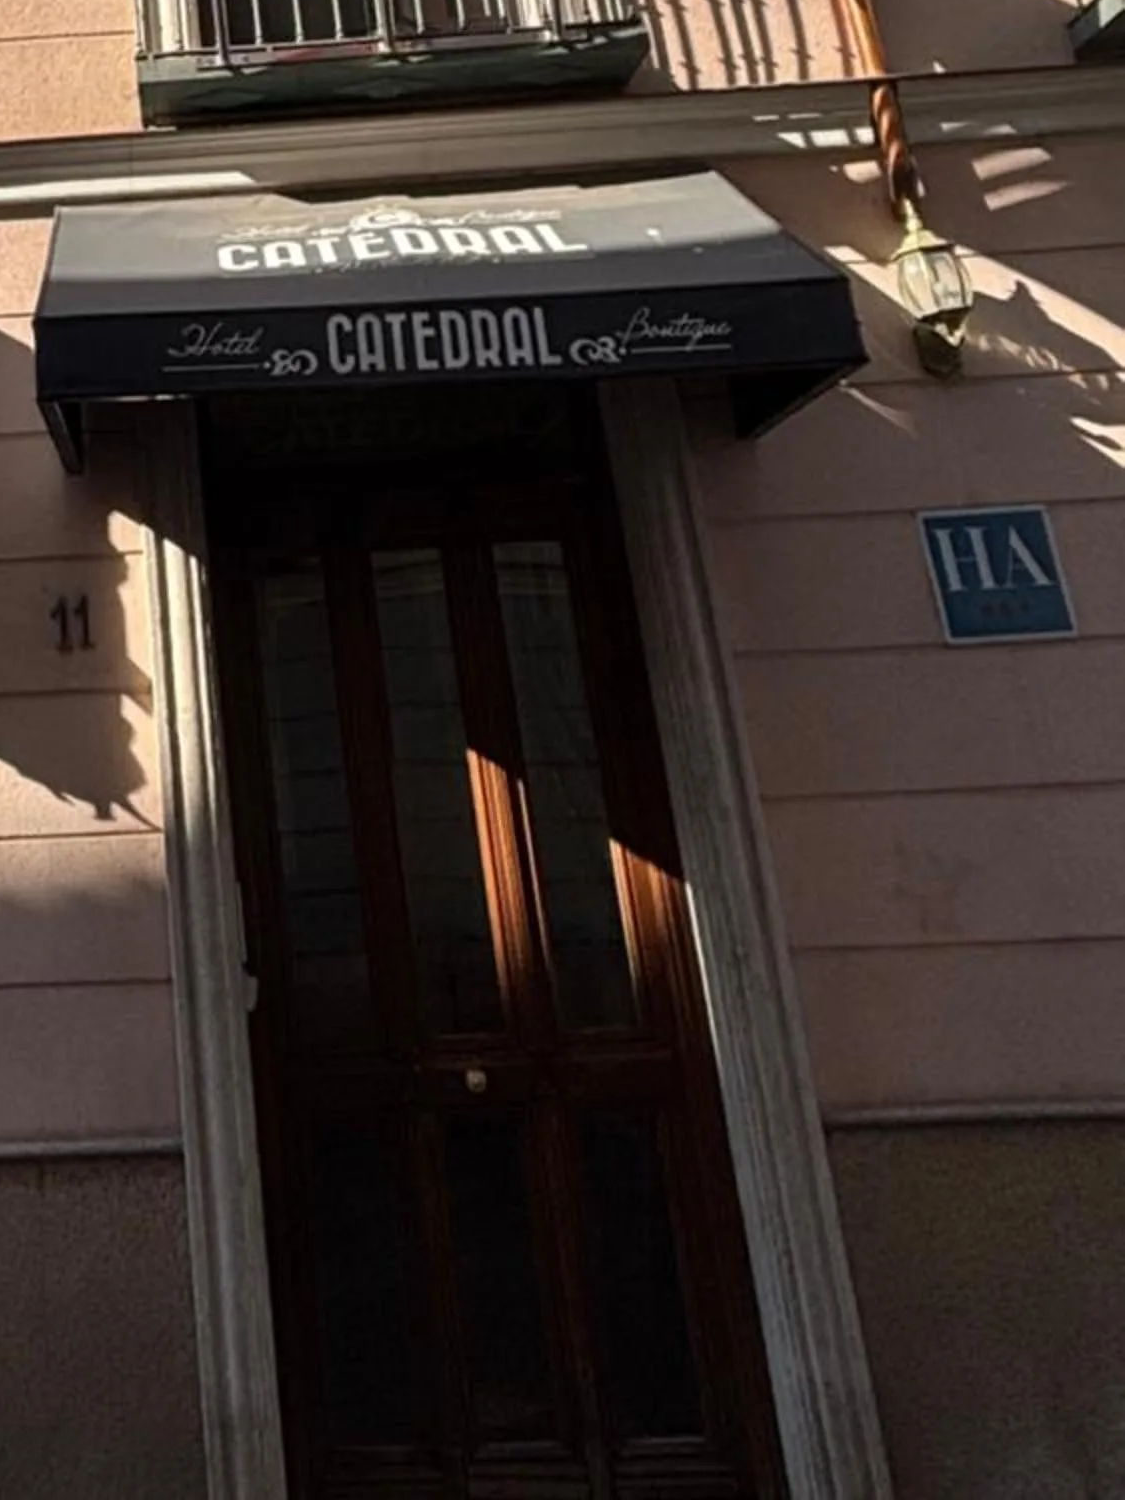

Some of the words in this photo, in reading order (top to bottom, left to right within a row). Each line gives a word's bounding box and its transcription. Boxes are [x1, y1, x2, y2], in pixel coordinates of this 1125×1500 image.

[217, 223, 588, 272] CATEDRAL
[168, 322, 265, 358] Hotel
[326, 306, 564, 375] CATEDRAL
[616, 306, 732, 351] Boutique
[50, 594, 97, 657] 11
